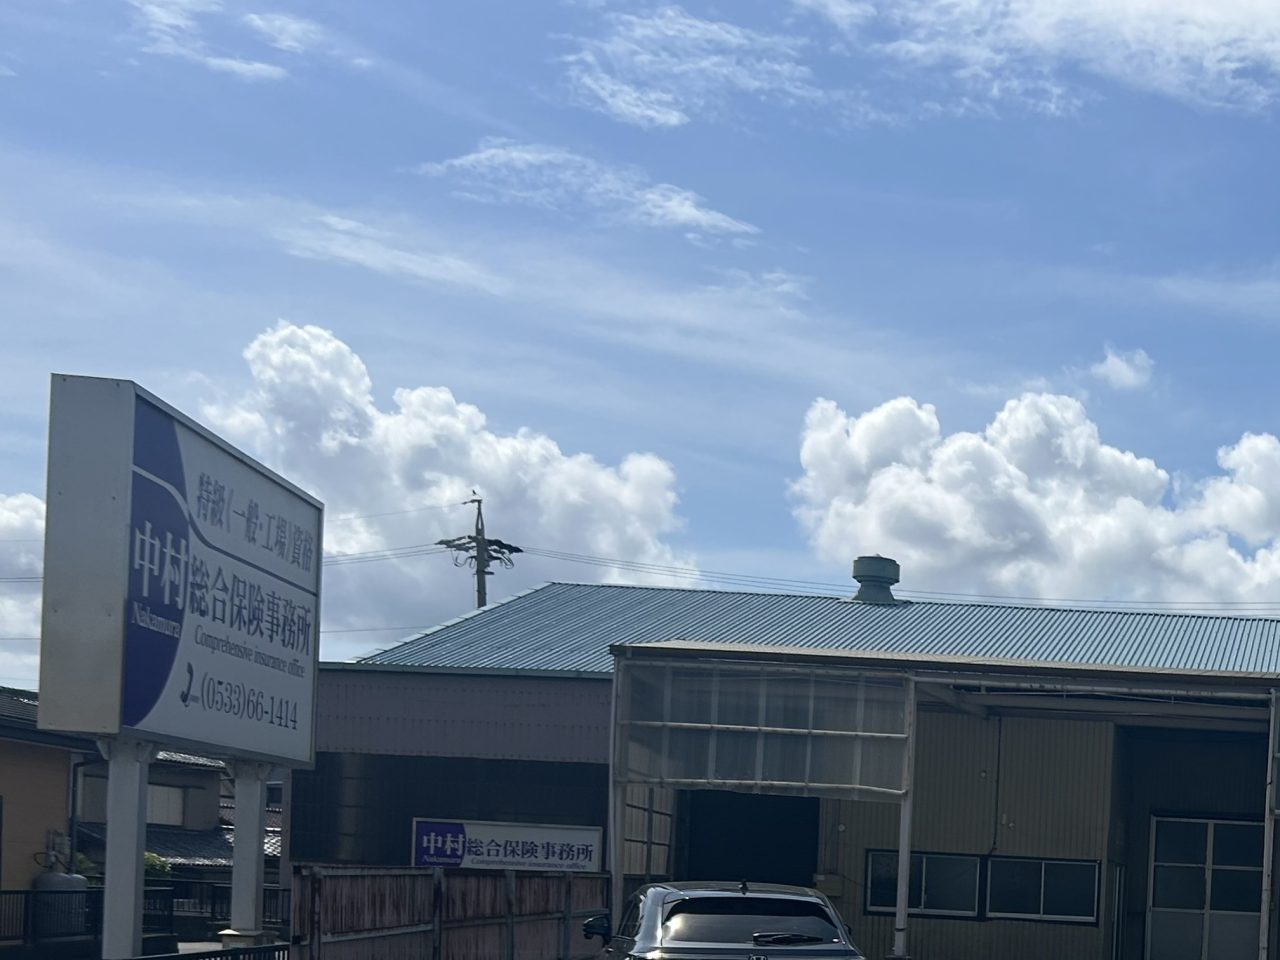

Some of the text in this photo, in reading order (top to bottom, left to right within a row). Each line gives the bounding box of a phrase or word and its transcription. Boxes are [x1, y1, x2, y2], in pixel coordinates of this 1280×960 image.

[131, 602, 181, 638] Nakamura
[194, 625, 305, 678] Comprehensive insurance office
[201, 672, 298, 730] (0533)66-1414
